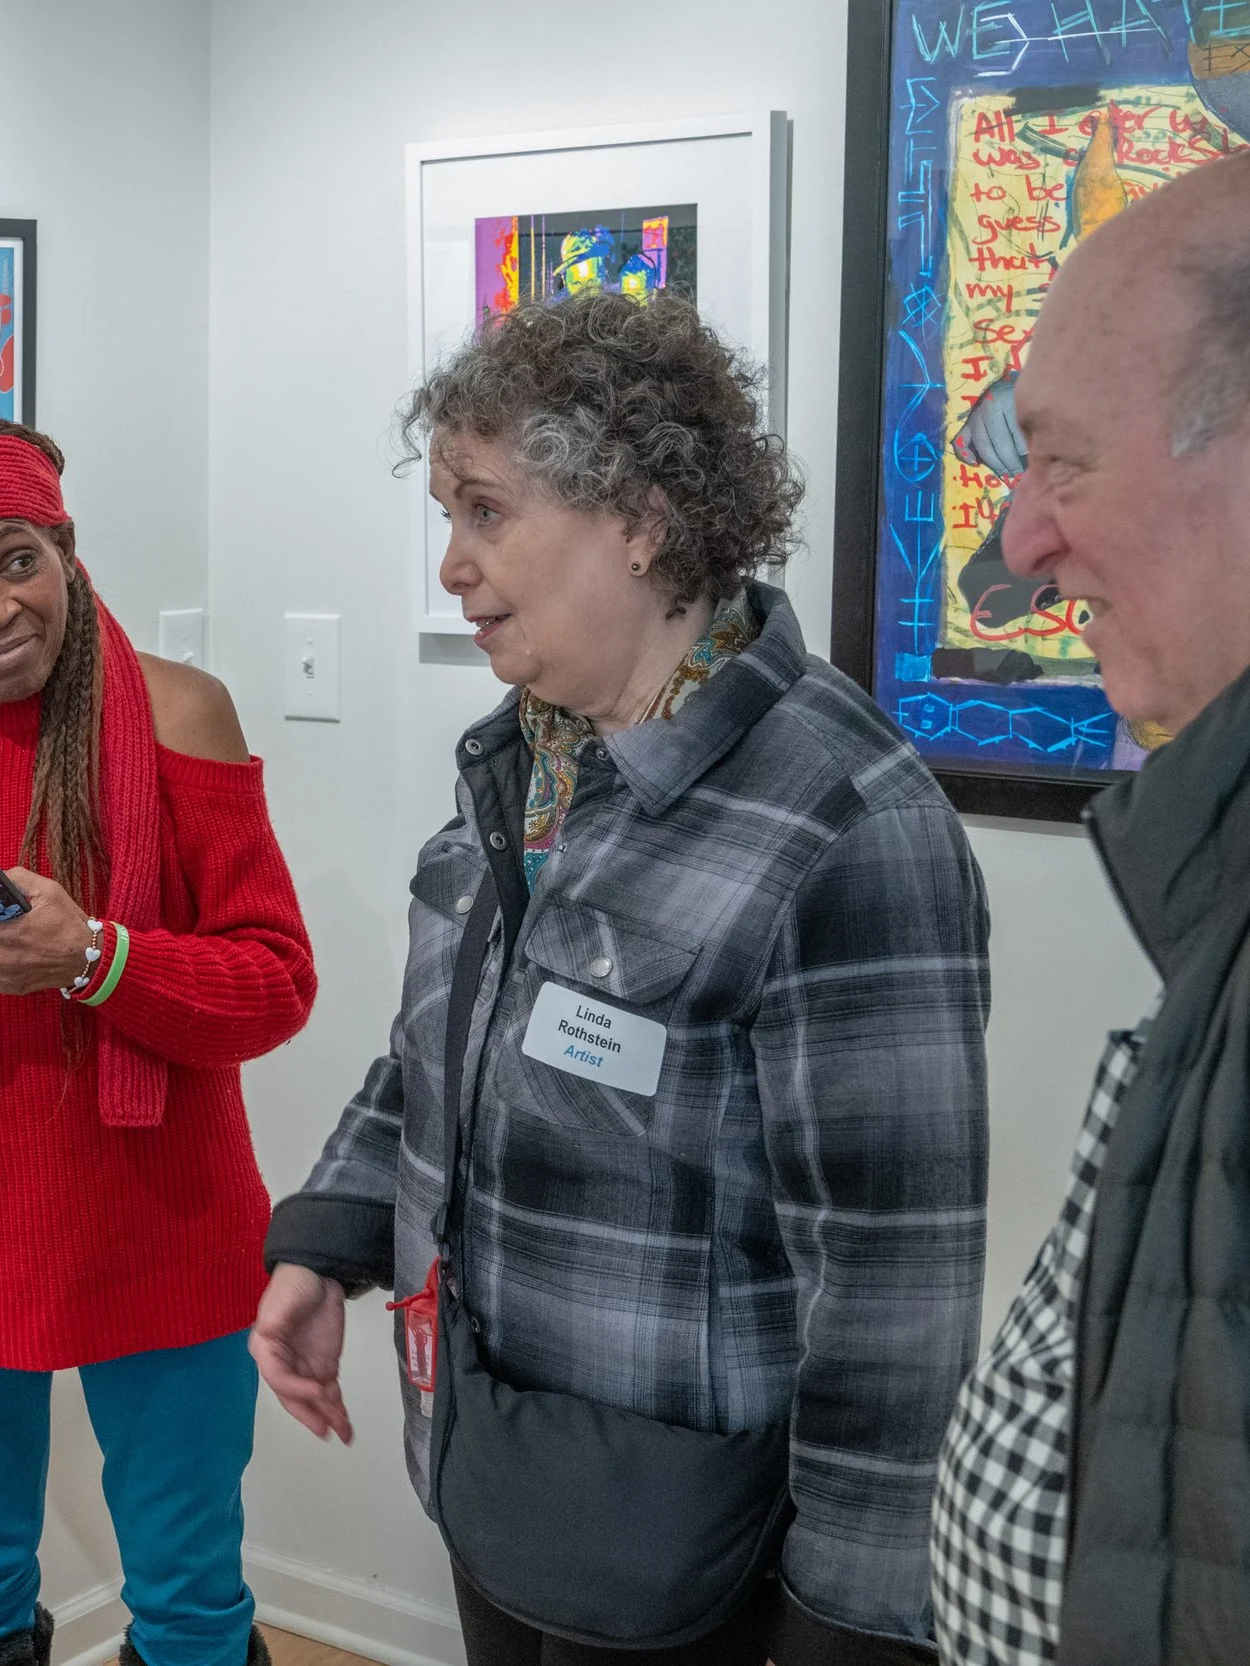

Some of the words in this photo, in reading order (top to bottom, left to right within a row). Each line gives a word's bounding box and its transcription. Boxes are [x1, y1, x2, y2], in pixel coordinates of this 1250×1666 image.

[974, 110, 1015, 142] All
[973, 146, 1040, 170] was
[970, 183, 1006, 202] to
[1025, 175, 1068, 201] be
[977, 214, 1061, 244] guess
[969, 243, 1049, 271] that
[966, 283, 1013, 313] my
[576, 1005, 612, 1029] Linda
[558, 1019, 621, 1053] Rothstein
[563, 1045, 605, 1068] Artist
